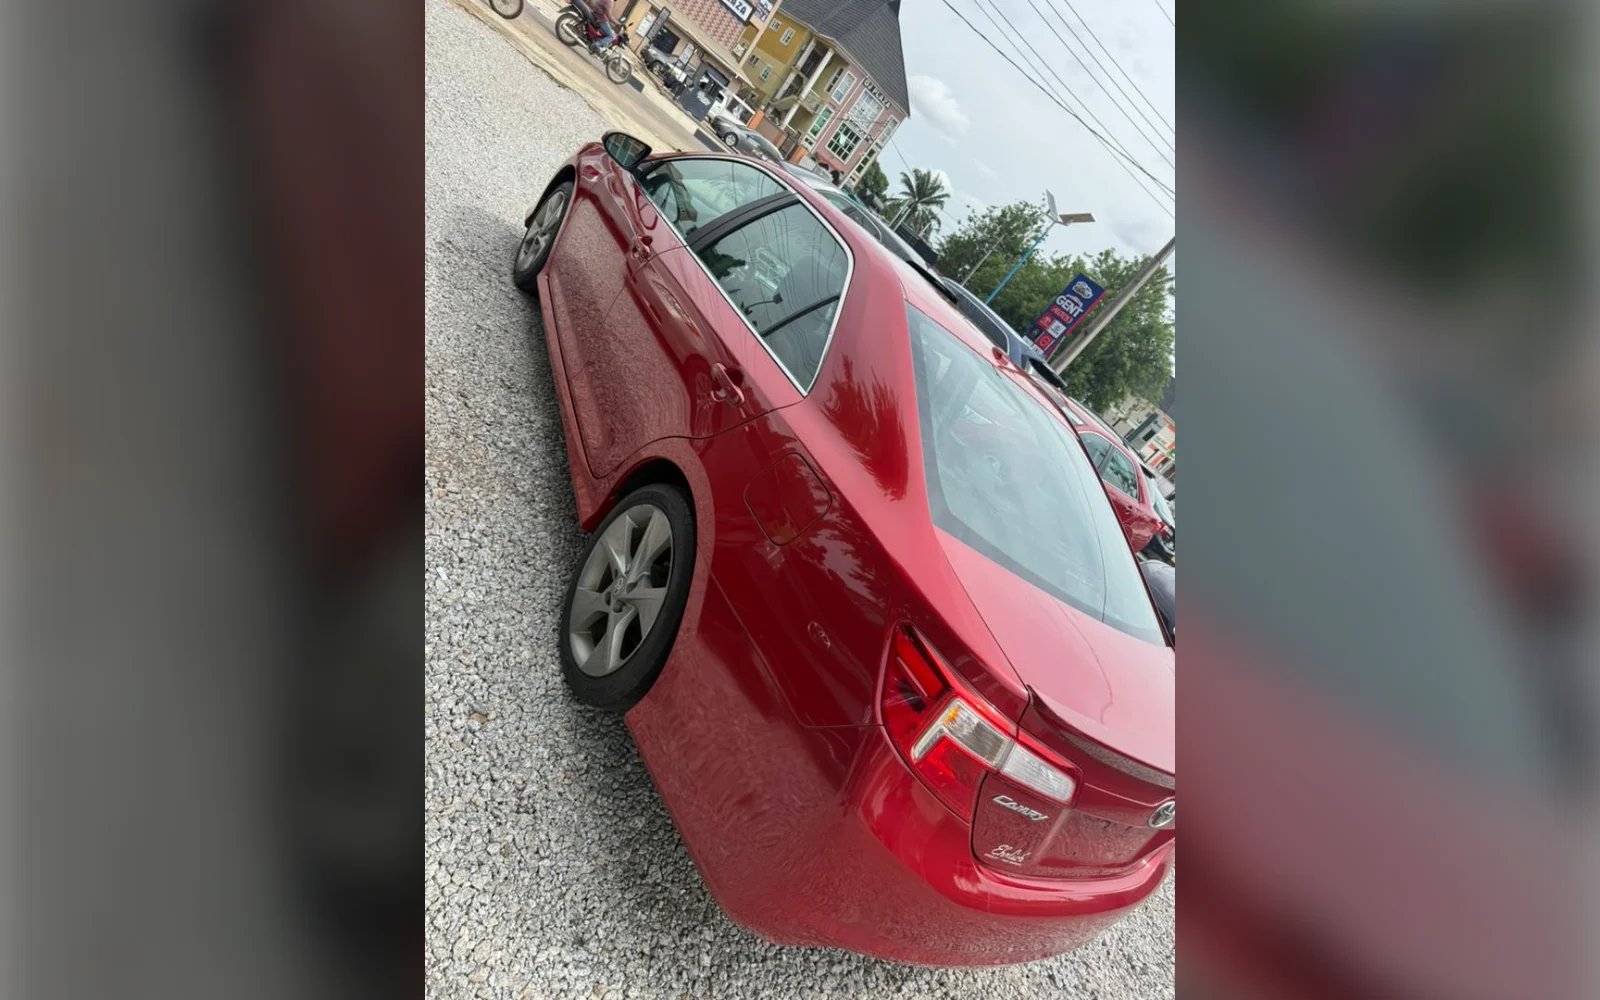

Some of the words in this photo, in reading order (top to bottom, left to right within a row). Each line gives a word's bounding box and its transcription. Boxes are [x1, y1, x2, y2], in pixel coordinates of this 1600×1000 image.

[728, 0, 747, 15] AZA
[873, 88, 890, 108] PLAZA
[1056, 295, 1083, 317] GENT
